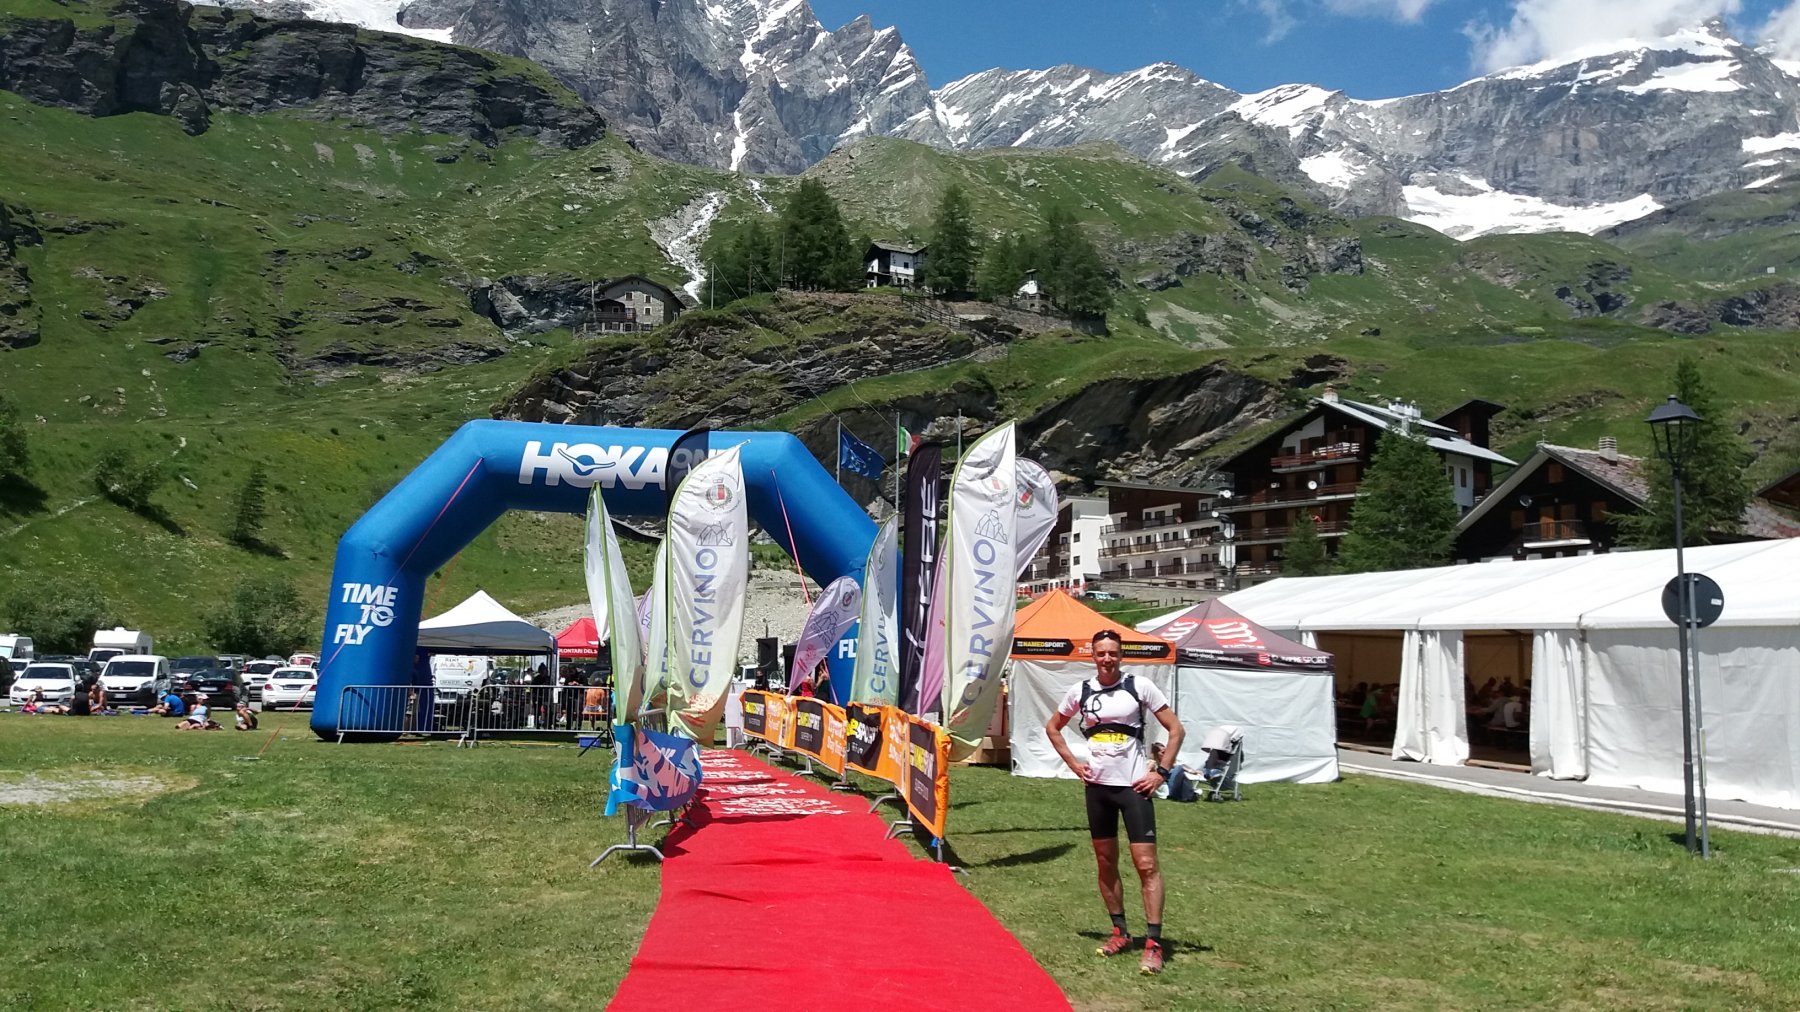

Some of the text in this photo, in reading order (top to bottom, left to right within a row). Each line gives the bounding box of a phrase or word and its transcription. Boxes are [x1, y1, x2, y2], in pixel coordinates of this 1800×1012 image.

[518, 440, 669, 491] HOKA
[342, 583, 399, 607] TIME
[333, 623, 375, 645] FLY
[360, 604, 396, 627] TO
[689, 548, 719, 688] CERVINO
[961, 538, 996, 707] CERVINO
